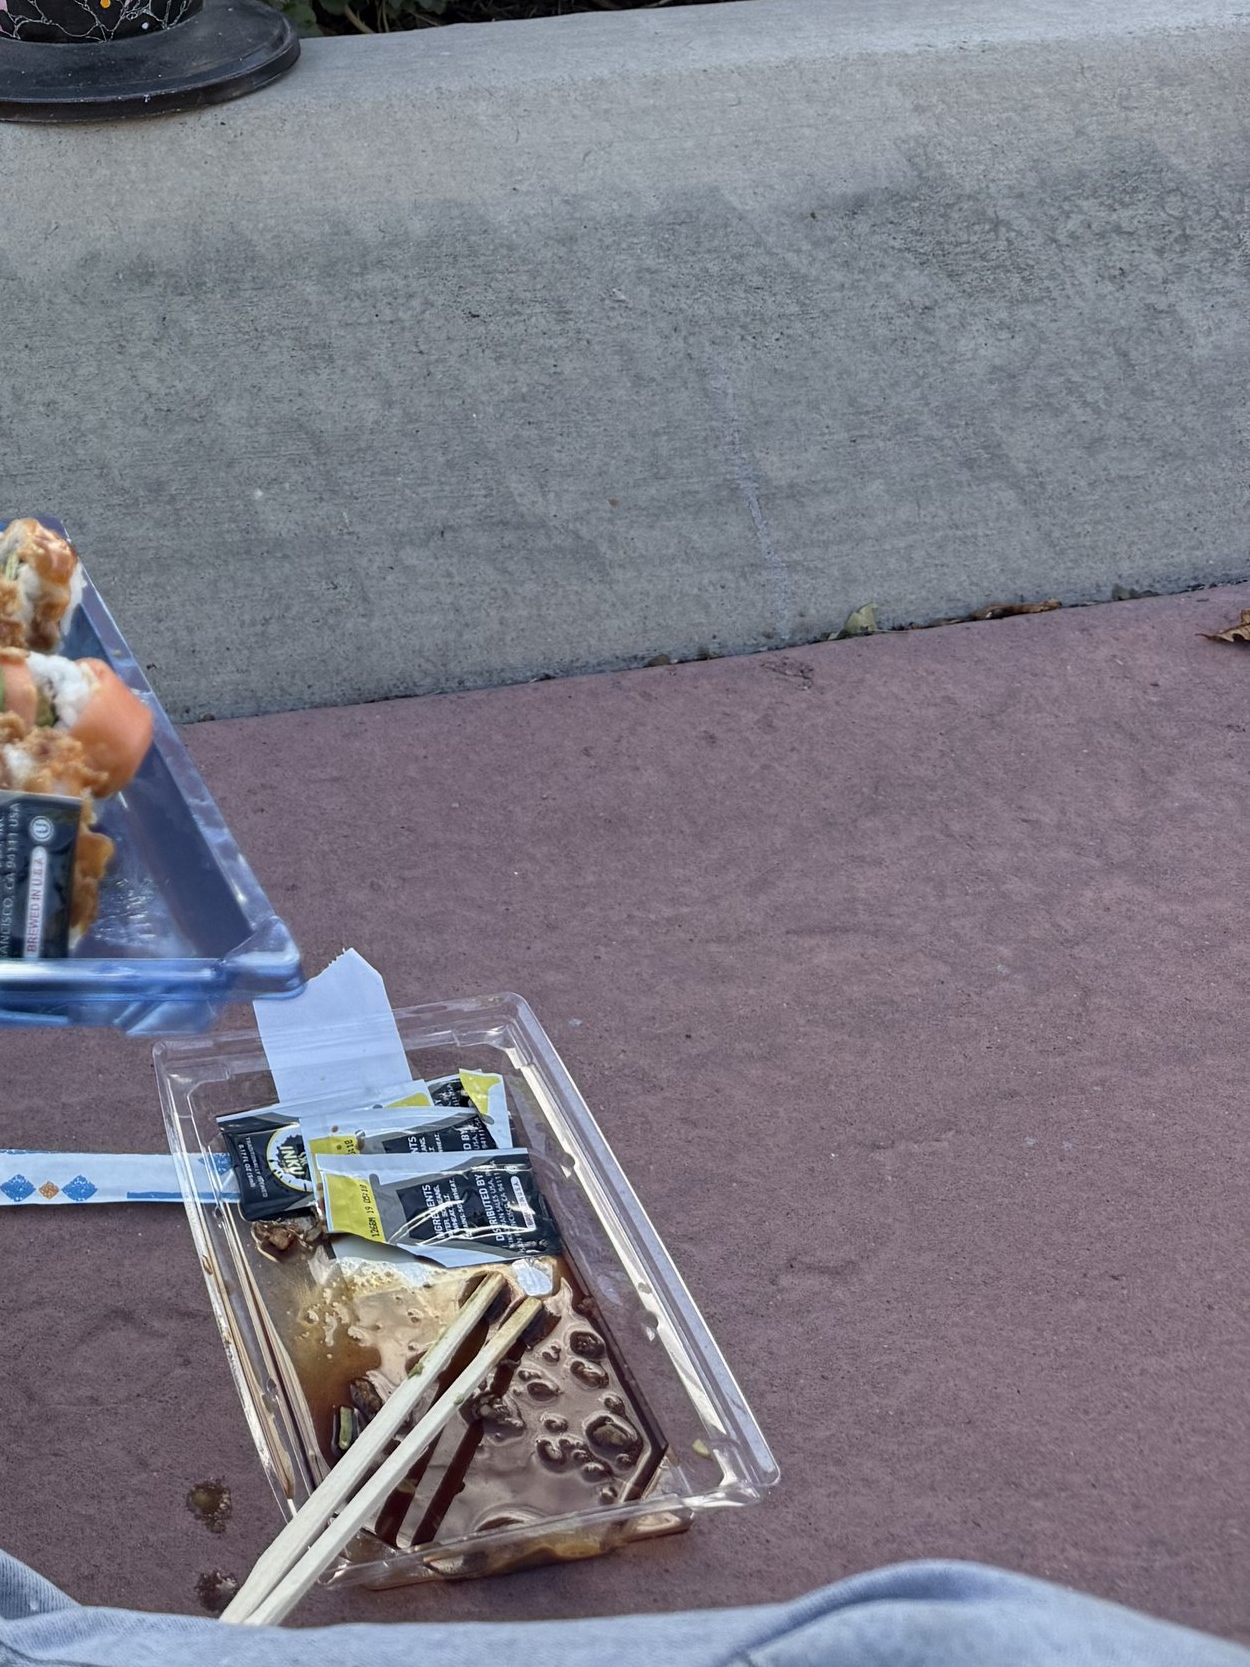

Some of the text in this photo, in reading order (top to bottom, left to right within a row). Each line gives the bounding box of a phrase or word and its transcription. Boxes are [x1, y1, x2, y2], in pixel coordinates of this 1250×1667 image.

[9, 803, 21, 828] USA
[4, 873, 16, 891] CA
[31, 887, 41, 901] IN
[27, 905, 41, 953] BREWED
[474, 1174, 486, 1187] BY
